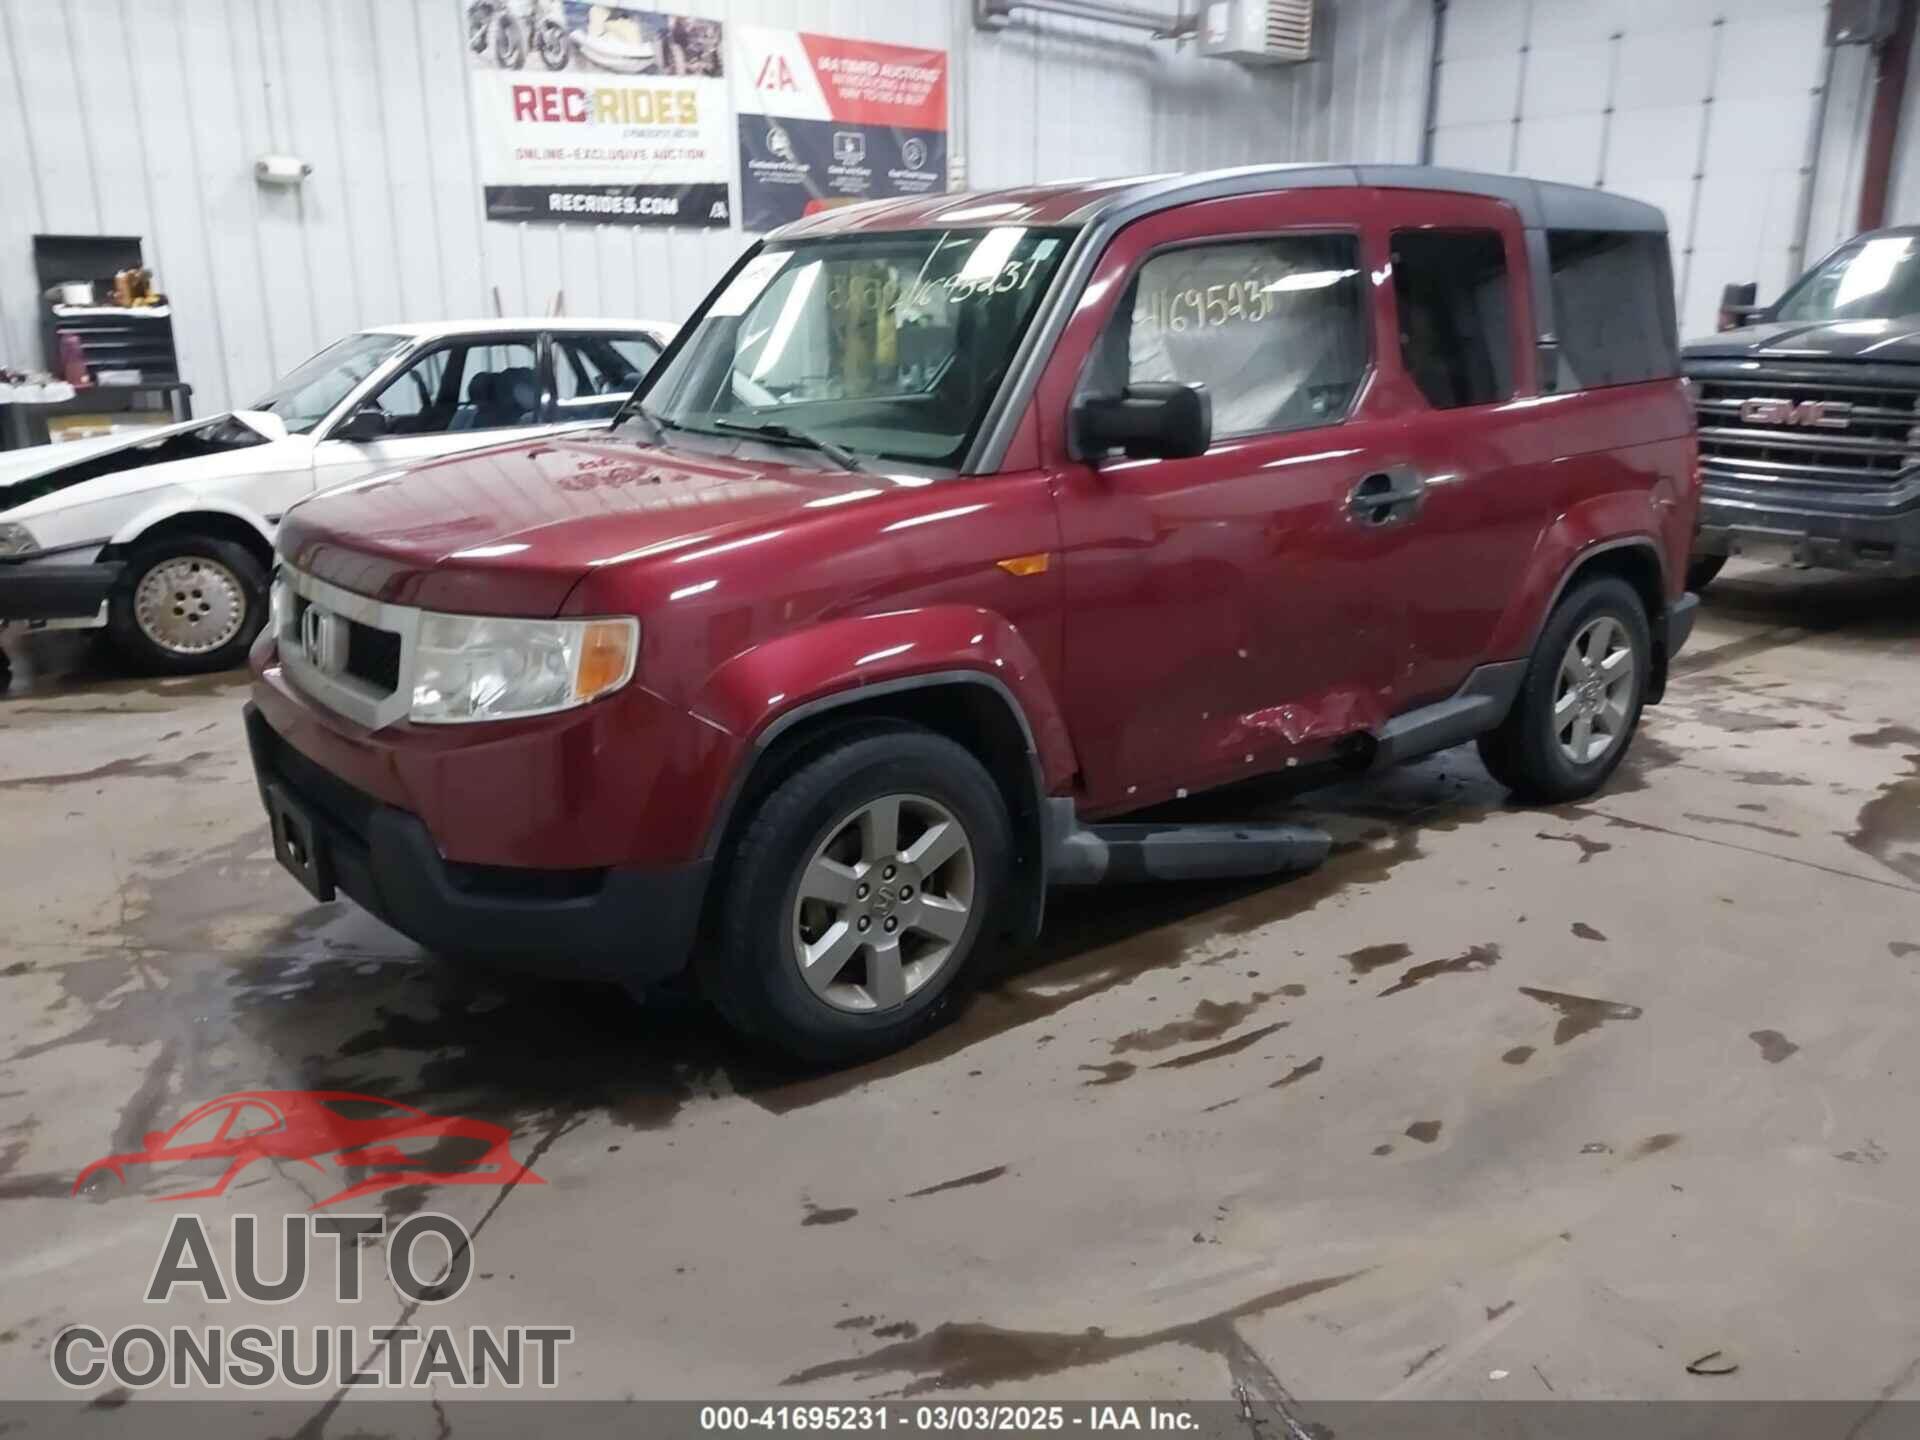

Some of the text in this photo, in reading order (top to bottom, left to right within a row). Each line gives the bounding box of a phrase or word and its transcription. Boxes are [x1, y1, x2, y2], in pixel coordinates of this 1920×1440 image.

[512, 84, 698, 125] REC RIDES
[549, 193, 679, 215] RECRIDES.COM
[1739, 398, 1851, 427] GMC
